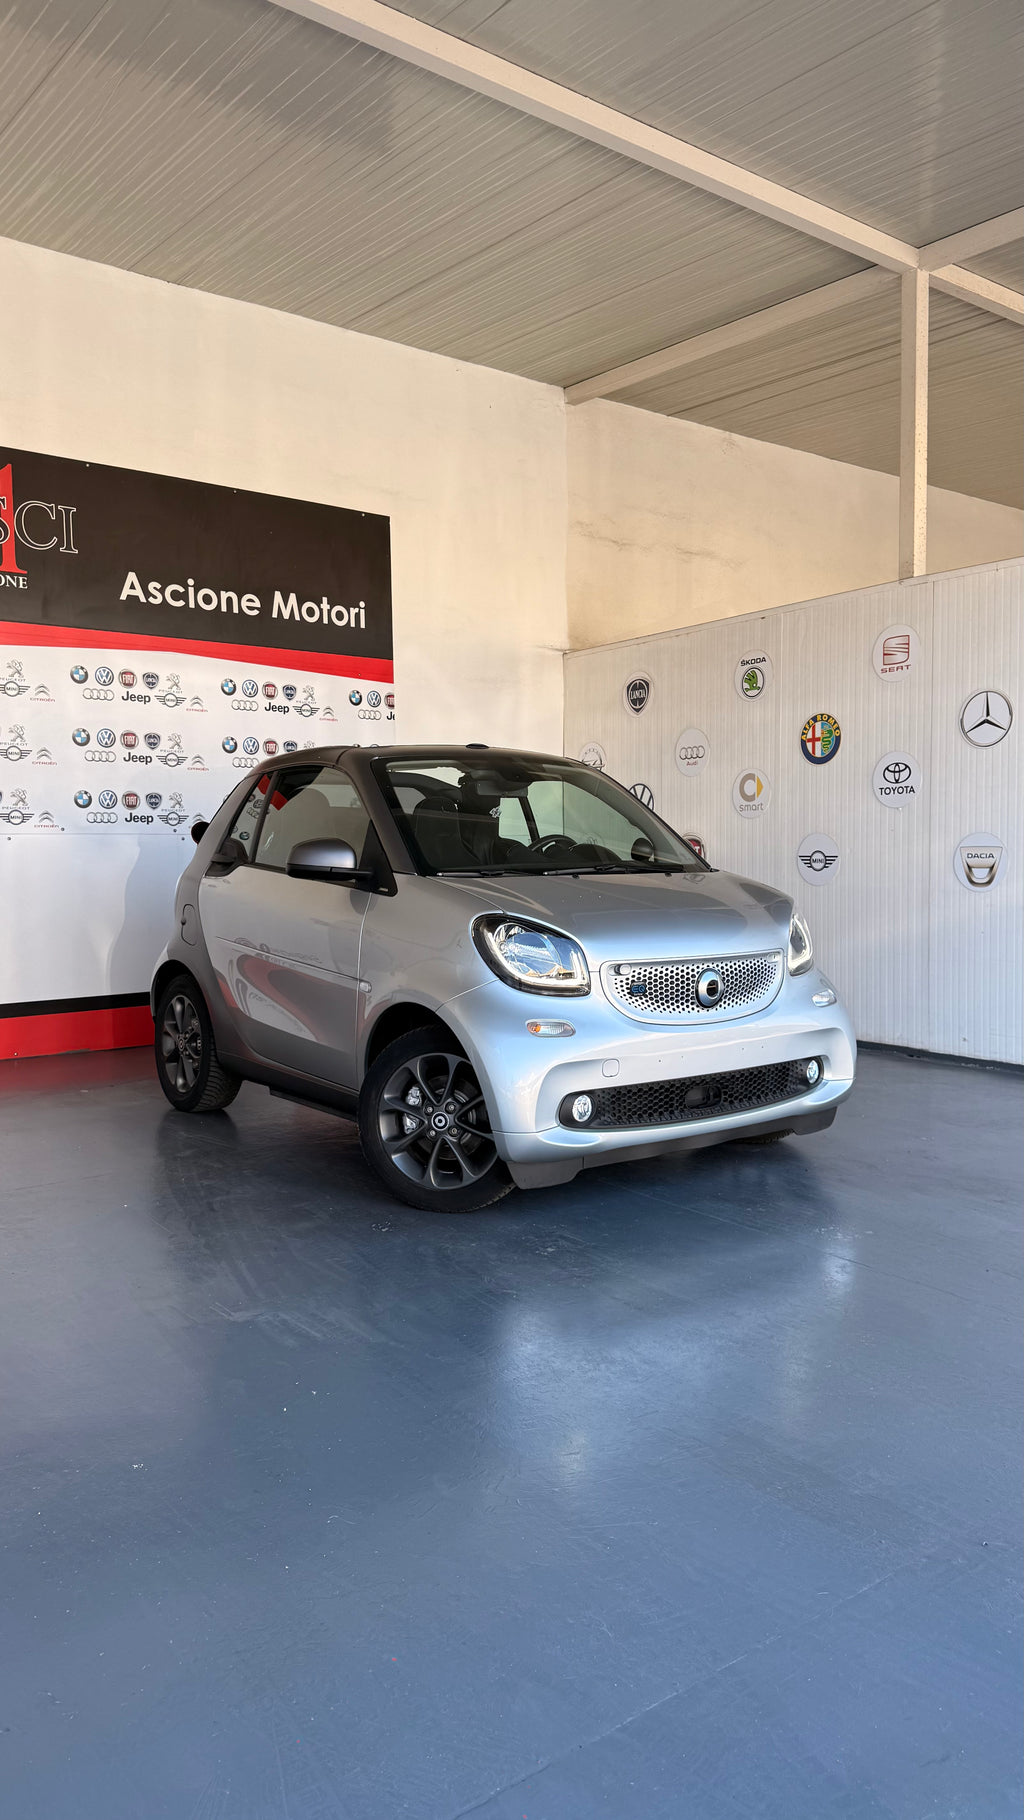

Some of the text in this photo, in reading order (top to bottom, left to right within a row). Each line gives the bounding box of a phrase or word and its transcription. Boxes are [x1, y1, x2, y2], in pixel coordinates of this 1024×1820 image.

[120, 571, 366, 629] Ascione Motori
[740, 656, 767, 667] ŠKODA
[880, 664, 911, 674] SEAT
[121, 690, 151, 705] Jeep
[264, 701, 290, 715] Jeep
[801, 713, 841, 741] ALFA ROMEO
[123, 751, 153, 765] Jeep
[878, 785, 916, 796] TOYOTA
[738, 802, 764, 812] smart
[124, 812, 154, 825] Jeep
[966, 852, 995, 860] DACIA
